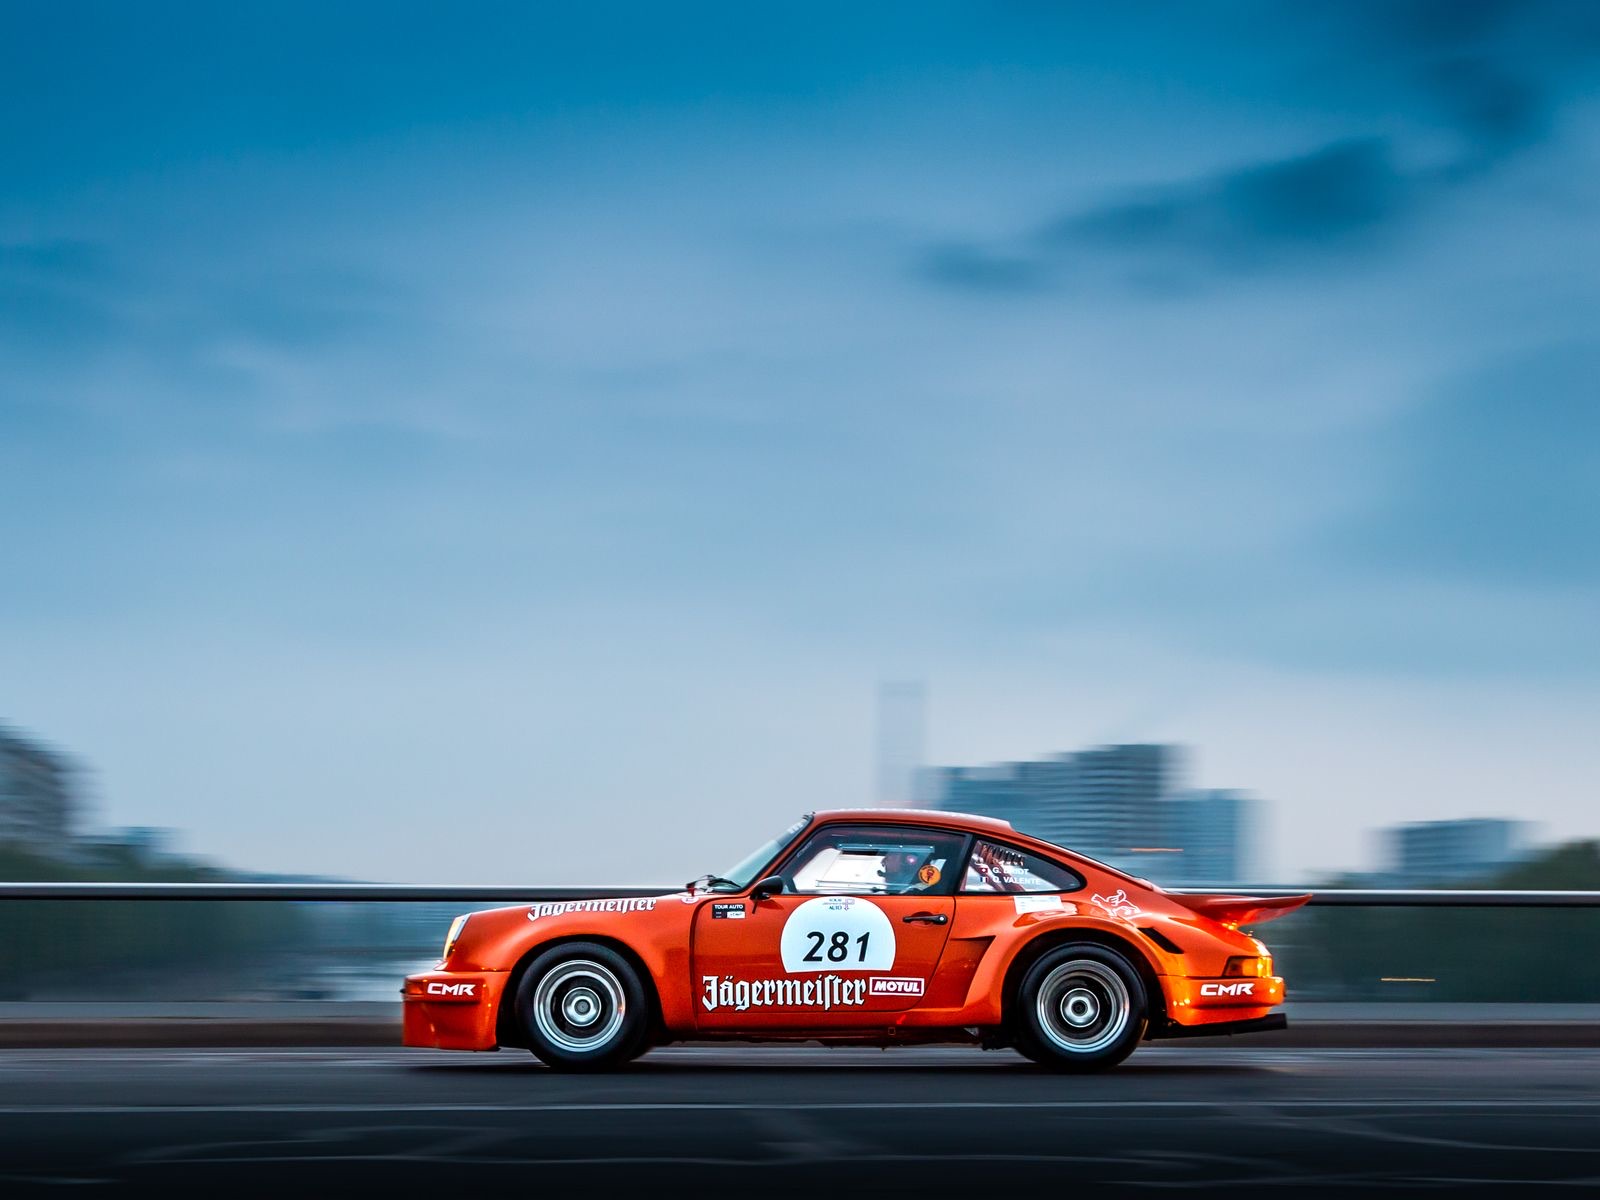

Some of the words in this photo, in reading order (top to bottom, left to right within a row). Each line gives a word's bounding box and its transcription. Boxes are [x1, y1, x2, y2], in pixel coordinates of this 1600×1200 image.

[802, 931, 871, 963] 281
[427, 982, 477, 996] CMR
[874, 979, 920, 993] MOTUL
[1200, 982, 1255, 996] CMR
